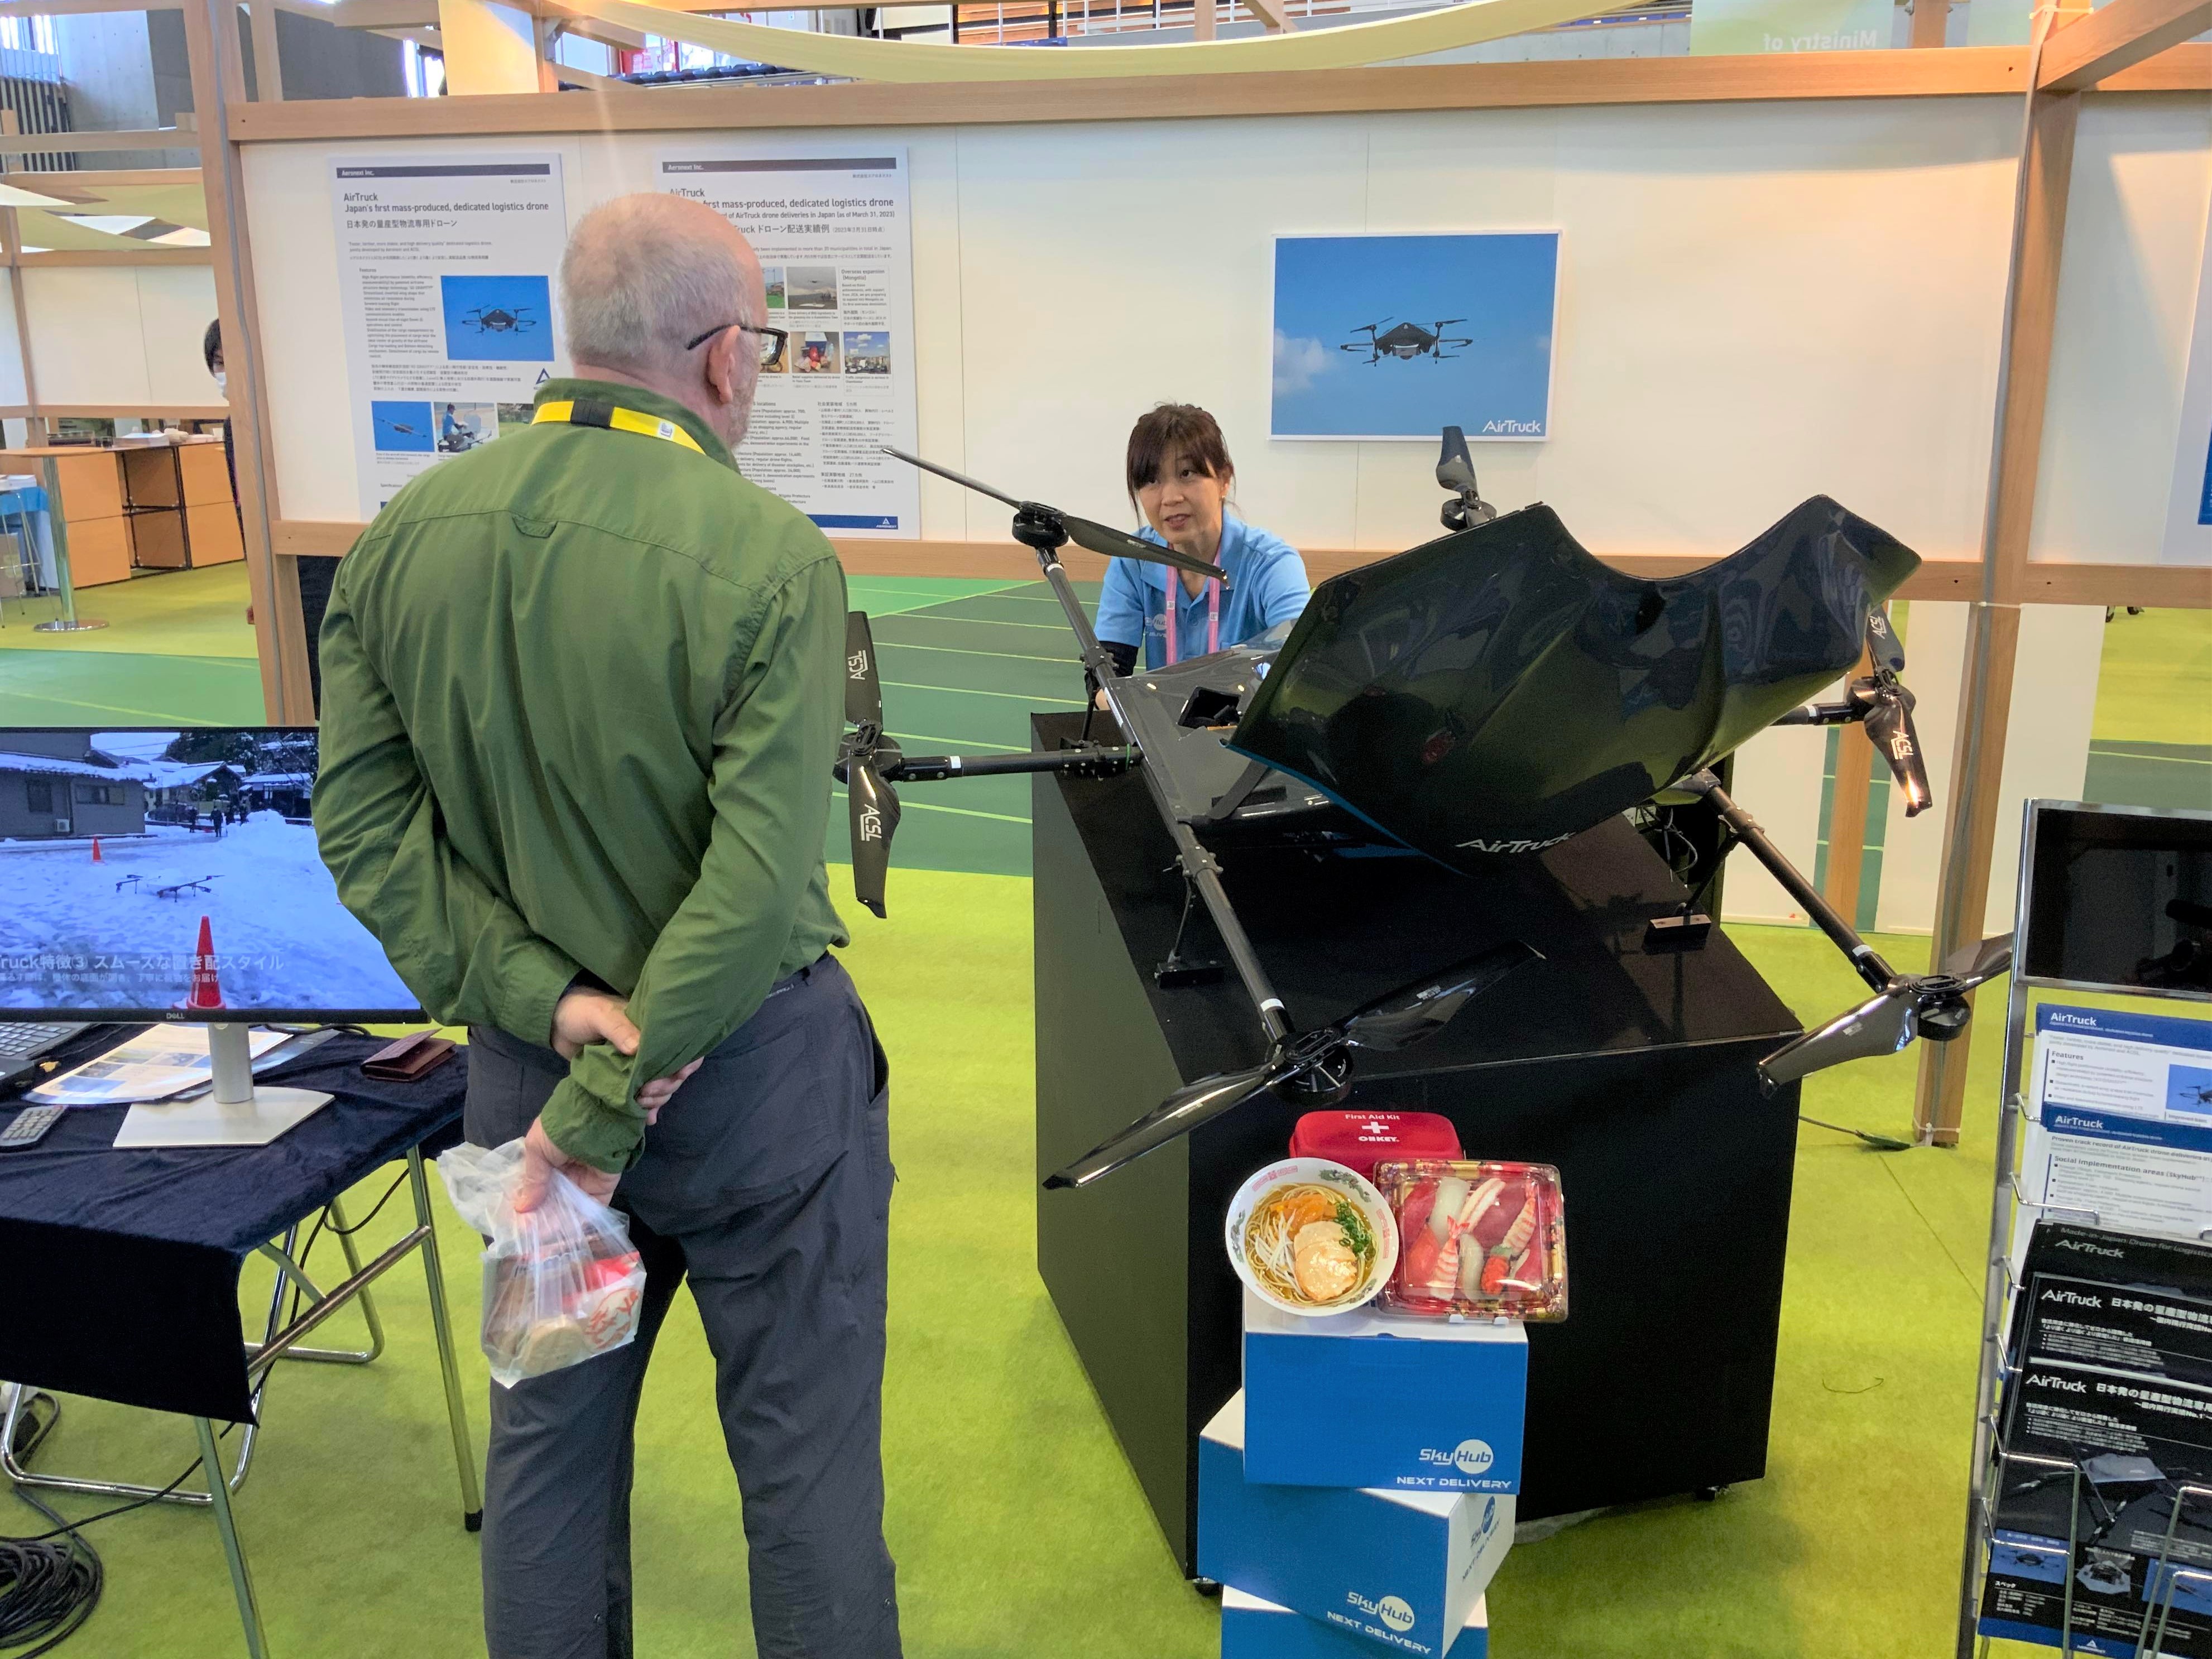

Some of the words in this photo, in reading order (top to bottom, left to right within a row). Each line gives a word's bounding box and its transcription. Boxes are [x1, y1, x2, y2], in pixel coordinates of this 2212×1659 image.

[344, 193, 378, 202] AirTruck
[670, 189, 705, 197] AirTruck
[345, 204, 373, 213] Japan's
[392, 203, 452, 213] mass-produced,
[454, 203, 490, 211] dedicated
[492, 202, 525, 212] logistics
[526, 202, 549, 210] drone
[722, 199, 788, 210] mass-produced,
[789, 199, 829, 208] dedicated
[832, 198, 867, 209] logistics
[869, 198, 894, 207] drone
[347, 219, 457, 229] 日本発の量産型物流専用ドローン
[759, 224, 830, 233] ドローン配送実績例
[1482, 420, 1541, 433] AirTruck
[1872, 615, 1887, 639] ACSL
[848, 650, 867, 681] ACSL
[1891, 730, 1913, 760] ACSL
[861, 804, 882, 841] ACSL
[1455, 832, 1577, 853] AirTruck
[2050, 1012, 2097, 1027] AirTruck
[2051, 1050, 2084, 1060] Features
[2055, 1115, 2104, 1130] AirTruck
[2122, 1145, 2149, 1153] AirTruck
[2171, 1151, 2201, 1161] deliveries
[2055, 1155, 2077, 1165] Social
[2078, 1158, 2141, 1173] implementation
[2055, 1239, 2125, 1258] AirTruck
[2041, 1289, 2102, 1308] AirTruck
[2026, 1374, 2087, 1393] AirTruck
[1419, 1448, 1493, 1465] SkyHub
[1397, 1476, 1436, 1485] NEXT
[1439, 1478, 1512, 1488] DELIVERY
[1347, 1591, 1414, 1623] SkyHub
[1327, 1611, 1361, 1629] NEXT
[1365, 1624, 1431, 1655] DELIVERY
